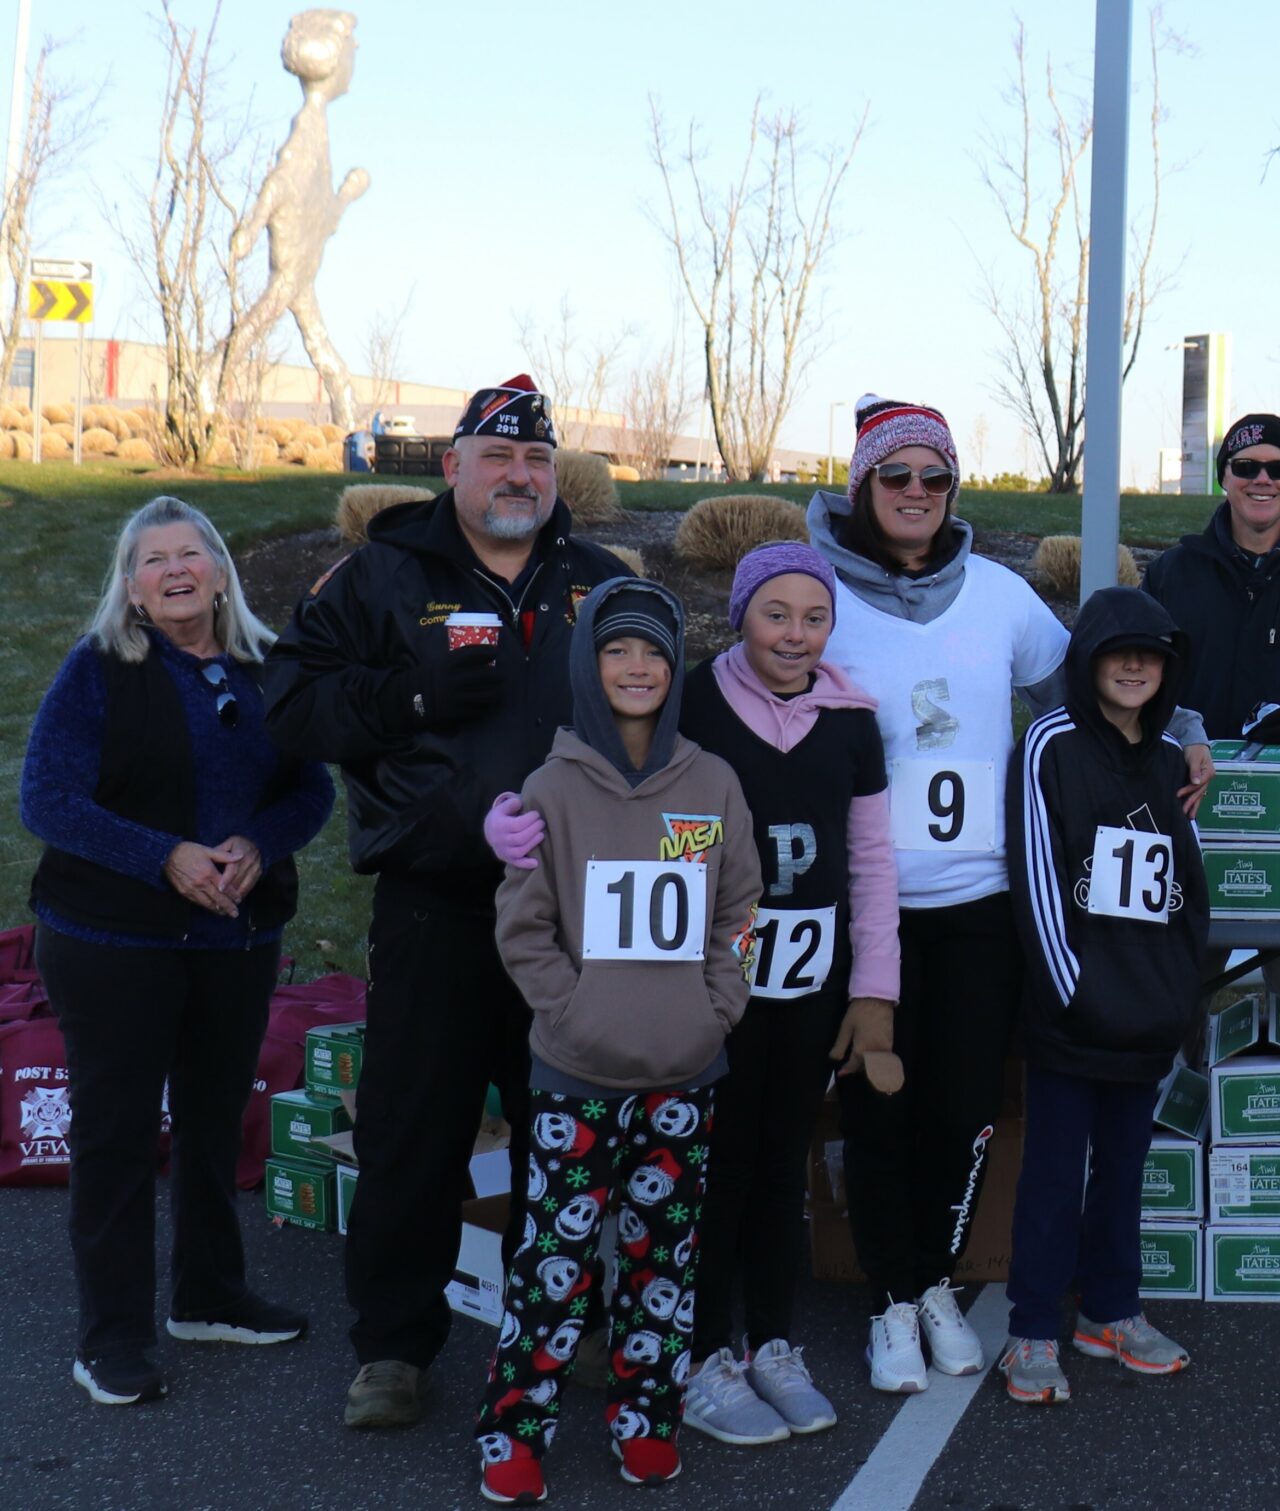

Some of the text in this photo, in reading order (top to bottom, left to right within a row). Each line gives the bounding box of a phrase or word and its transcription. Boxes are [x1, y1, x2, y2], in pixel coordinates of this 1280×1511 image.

[499, 414, 519, 425] VFW
[495, 424, 519, 435] 2913
[1222, 794, 1257, 805] TATE'S
[928, 771, 965, 842] 9
[660, 821, 723, 861] NASA
[1112, 839, 1169, 913] 13
[1228, 873, 1263, 883] TATE'S
[607, 871, 688, 951] 10
[754, 918, 822, 990] 12
[15, 1066, 51, 1081] POST
[1231, 1163, 1248, 1172] 164
[1143, 1172, 1166, 1183] TE'S
[950, 1125, 994, 1254] Champion
[1244, 1257, 1280, 1268] TATE'S
